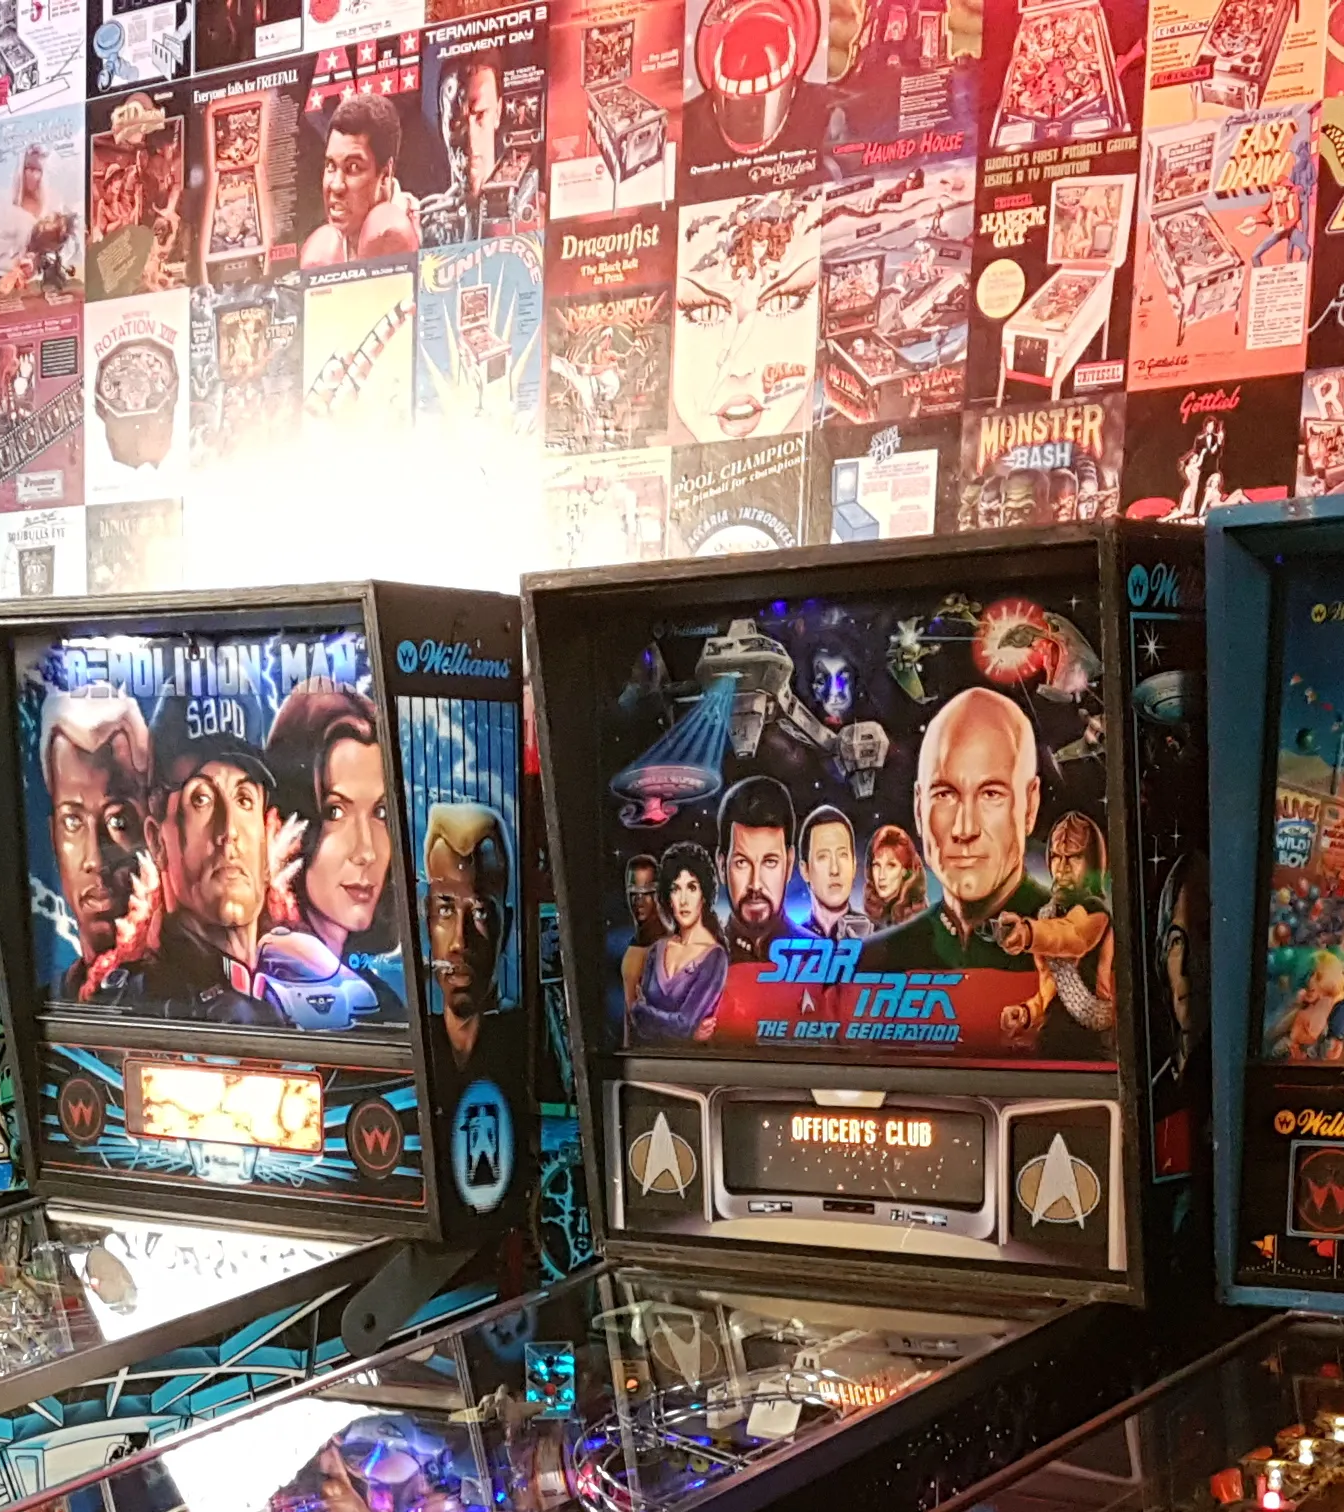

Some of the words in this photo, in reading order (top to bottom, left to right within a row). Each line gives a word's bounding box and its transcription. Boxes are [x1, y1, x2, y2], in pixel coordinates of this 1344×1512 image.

[426, 11, 532, 44] TERMINATOR
[535, 6, 547, 19] 2
[437, 35, 505, 59] JUDGMENT
[509, 28, 534, 44] DAY
[194, 85, 226, 104] Everyone
[227, 82, 243, 99] falls
[244, 80, 256, 93] for
[256, 69, 299, 91] FREEFALL
[863, 138, 916, 165] HAUNTED
[920, 131, 964, 153] HOUSE
[985, 152, 1029, 172] WORLD'S
[1032, 148, 1059, 165] FIRST
[1062, 142, 1103, 160] PINBALL
[1106, 136, 1138, 153] GAME
[1231, 119, 1297, 158] FAST
[984, 171, 1013, 188] USING
[1016, 170, 1024, 184] A
[1027, 167, 1040, 181] TV
[1043, 160, 1090, 180] MONITOR
[1215, 151, 1294, 195] DRAW
[980, 205, 1047, 234] HAREM
[561, 224, 660, 260] Dragonfist
[993, 226, 1027, 249] CAT
[310, 268, 366, 285] ZACCARIA
[439, 239, 542, 285] UNIVERSE
[581, 265, 595, 277] The
[598, 261, 620, 275] Black
[622, 258, 638, 271] Belt
[567, 296, 655, 324] DRAGONFIST
[94, 320, 156, 358] ROTATION
[159, 324, 178, 346] VIII
[1076, 365, 1122, 383] UNIVERSAL
[1180, 386, 1241, 424] Gottlieb
[977, 404, 1105, 476] MONSTER
[1014, 444, 1072, 469] BASH
[673, 472, 715, 497] POOL
[720, 437, 805, 481] CHAMPION
[692, 482, 728, 504] pinball
[731, 475, 745, 493] for
[739, 506, 795, 549] INTRODUCES
[67, 643, 261, 698] DEMOLITION
[282, 642, 357, 697] MAN
[420, 639, 511, 680] Williams
[1278, 850, 1308, 868] BOY
[757, 938, 862, 984] STAR
[854, 972, 964, 1020] TREK
[757, 1020, 787, 1037] THE
[794, 1022, 840, 1039] NEXT
[845, 1023, 959, 1042] GENERATION
[792, 1116, 877, 1145] OFFICER'S
[885, 1120, 932, 1147] CLUB
